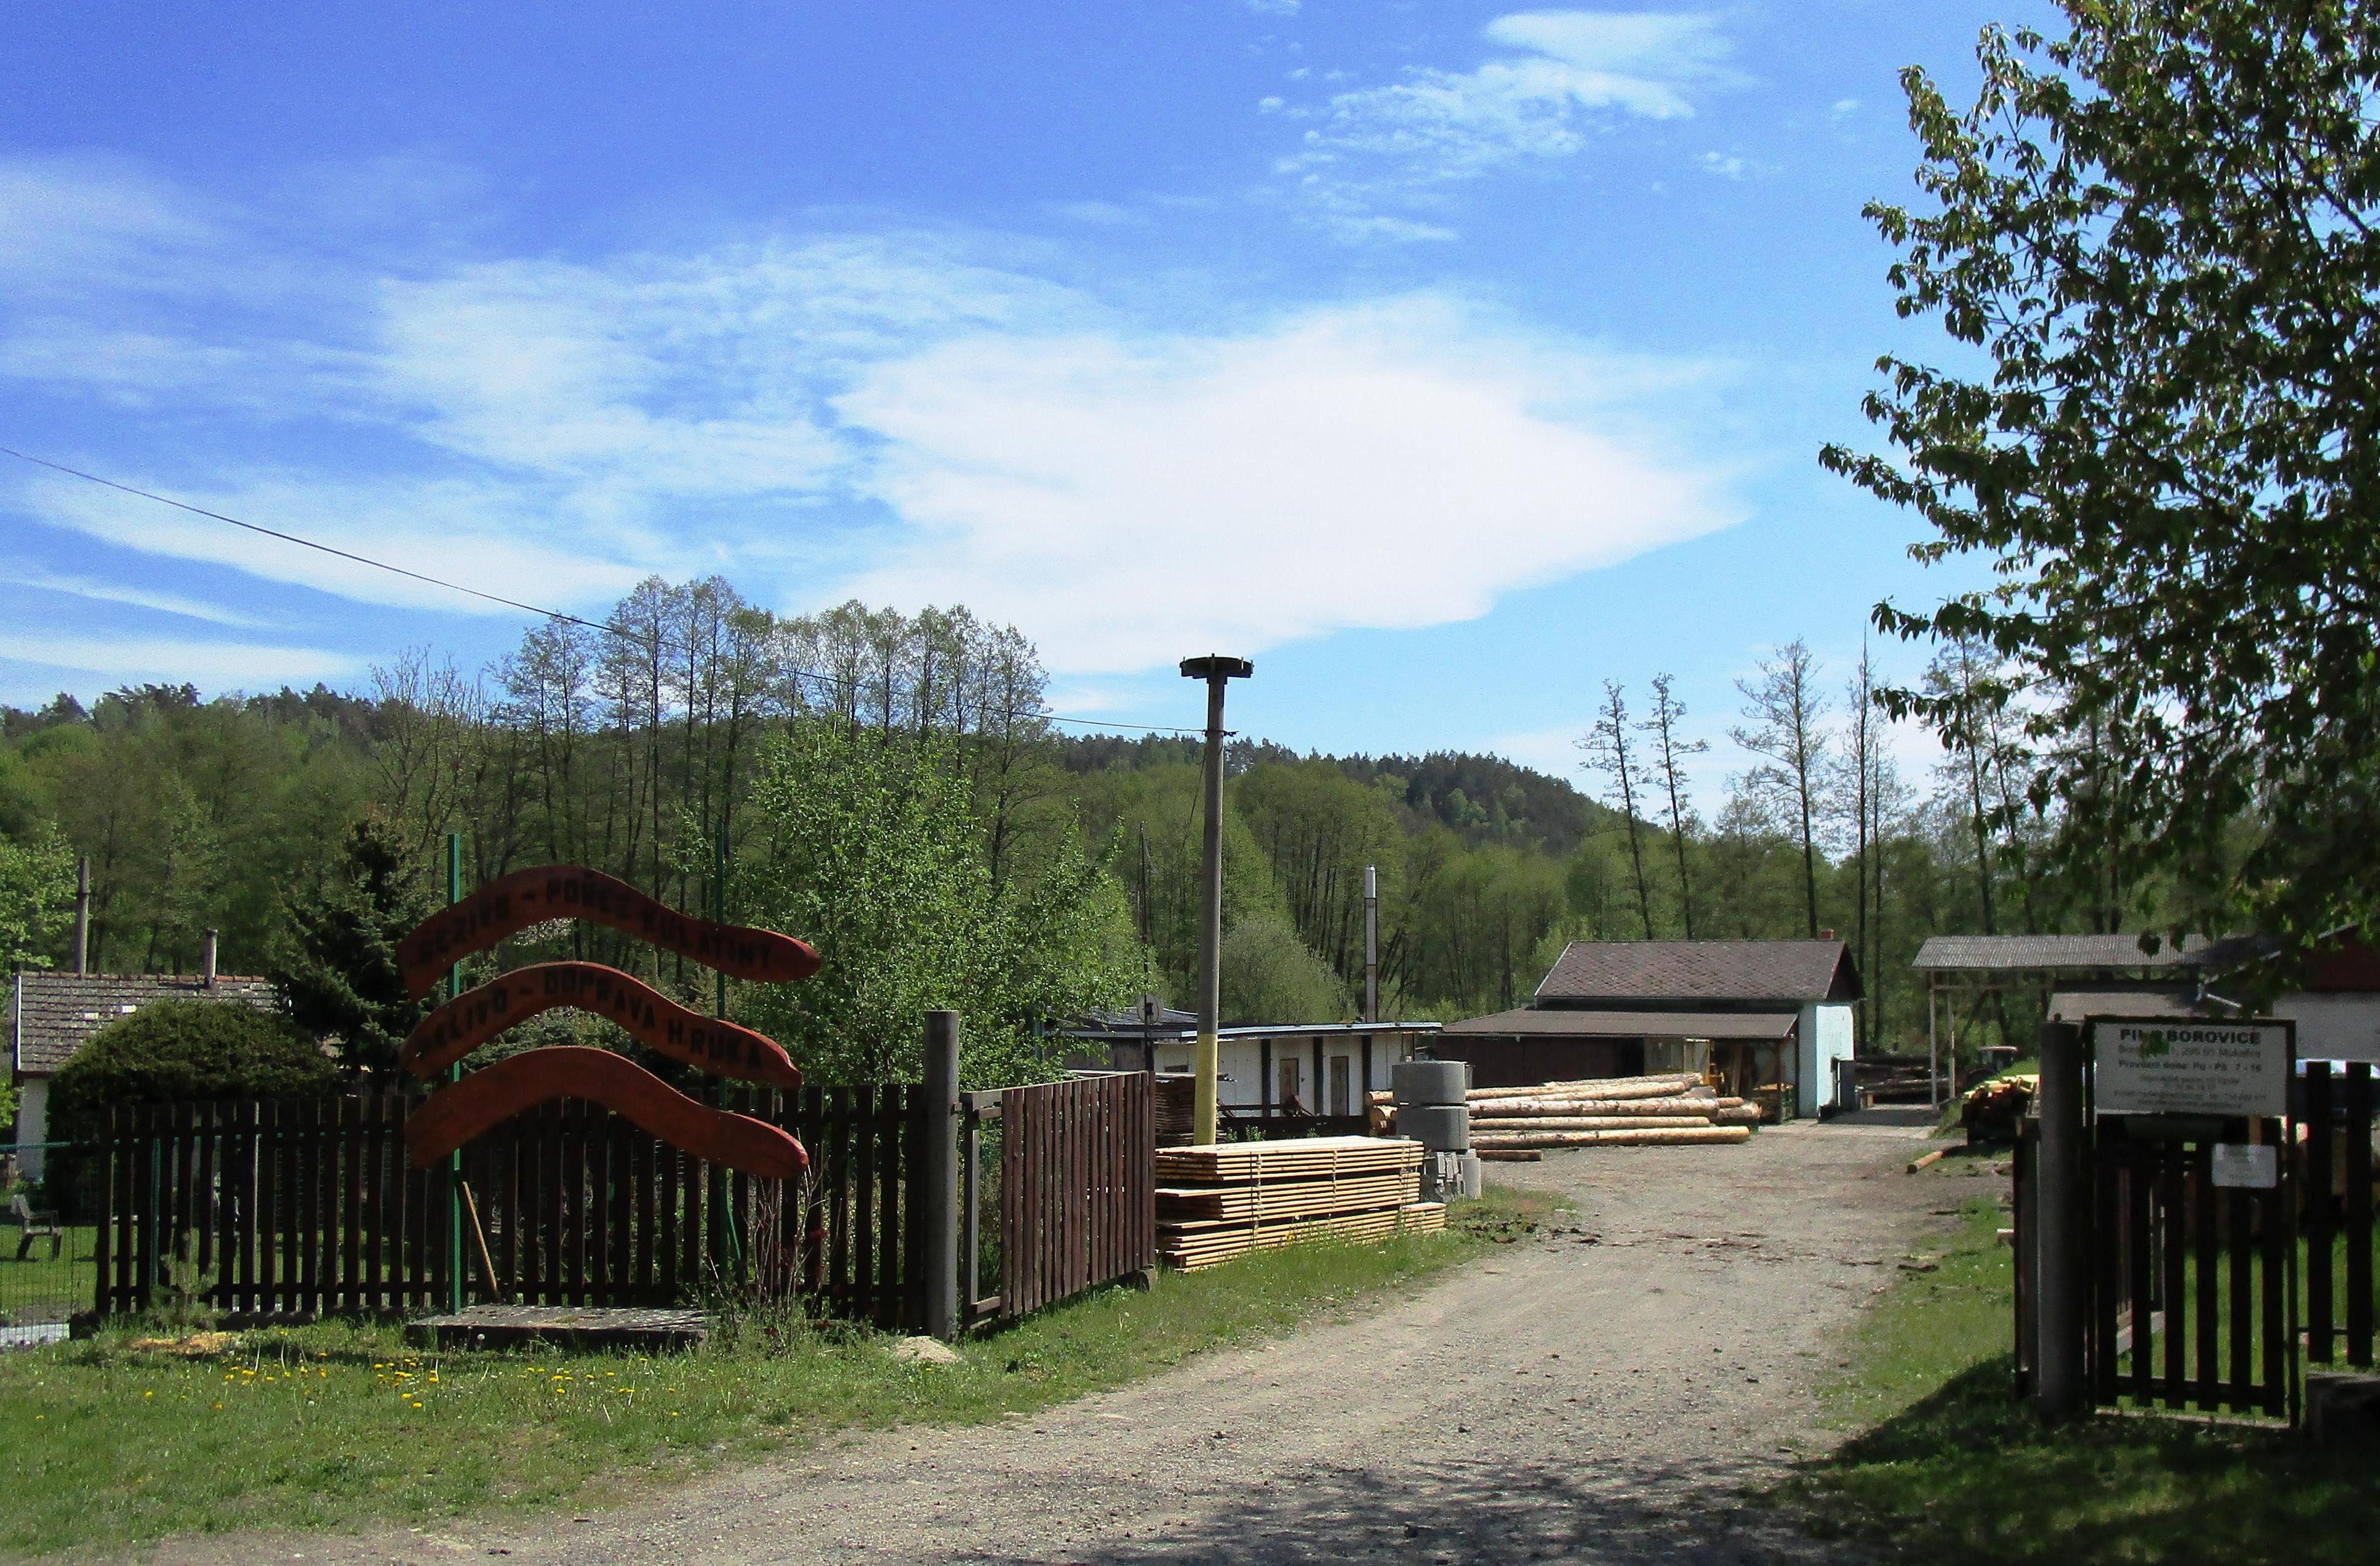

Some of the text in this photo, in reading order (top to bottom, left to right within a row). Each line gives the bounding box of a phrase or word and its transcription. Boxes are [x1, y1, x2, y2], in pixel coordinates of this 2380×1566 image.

[544, 968, 655, 1028] DOPRAVA
[2120, 1028, 2261, 1045] PI BOROVICE
